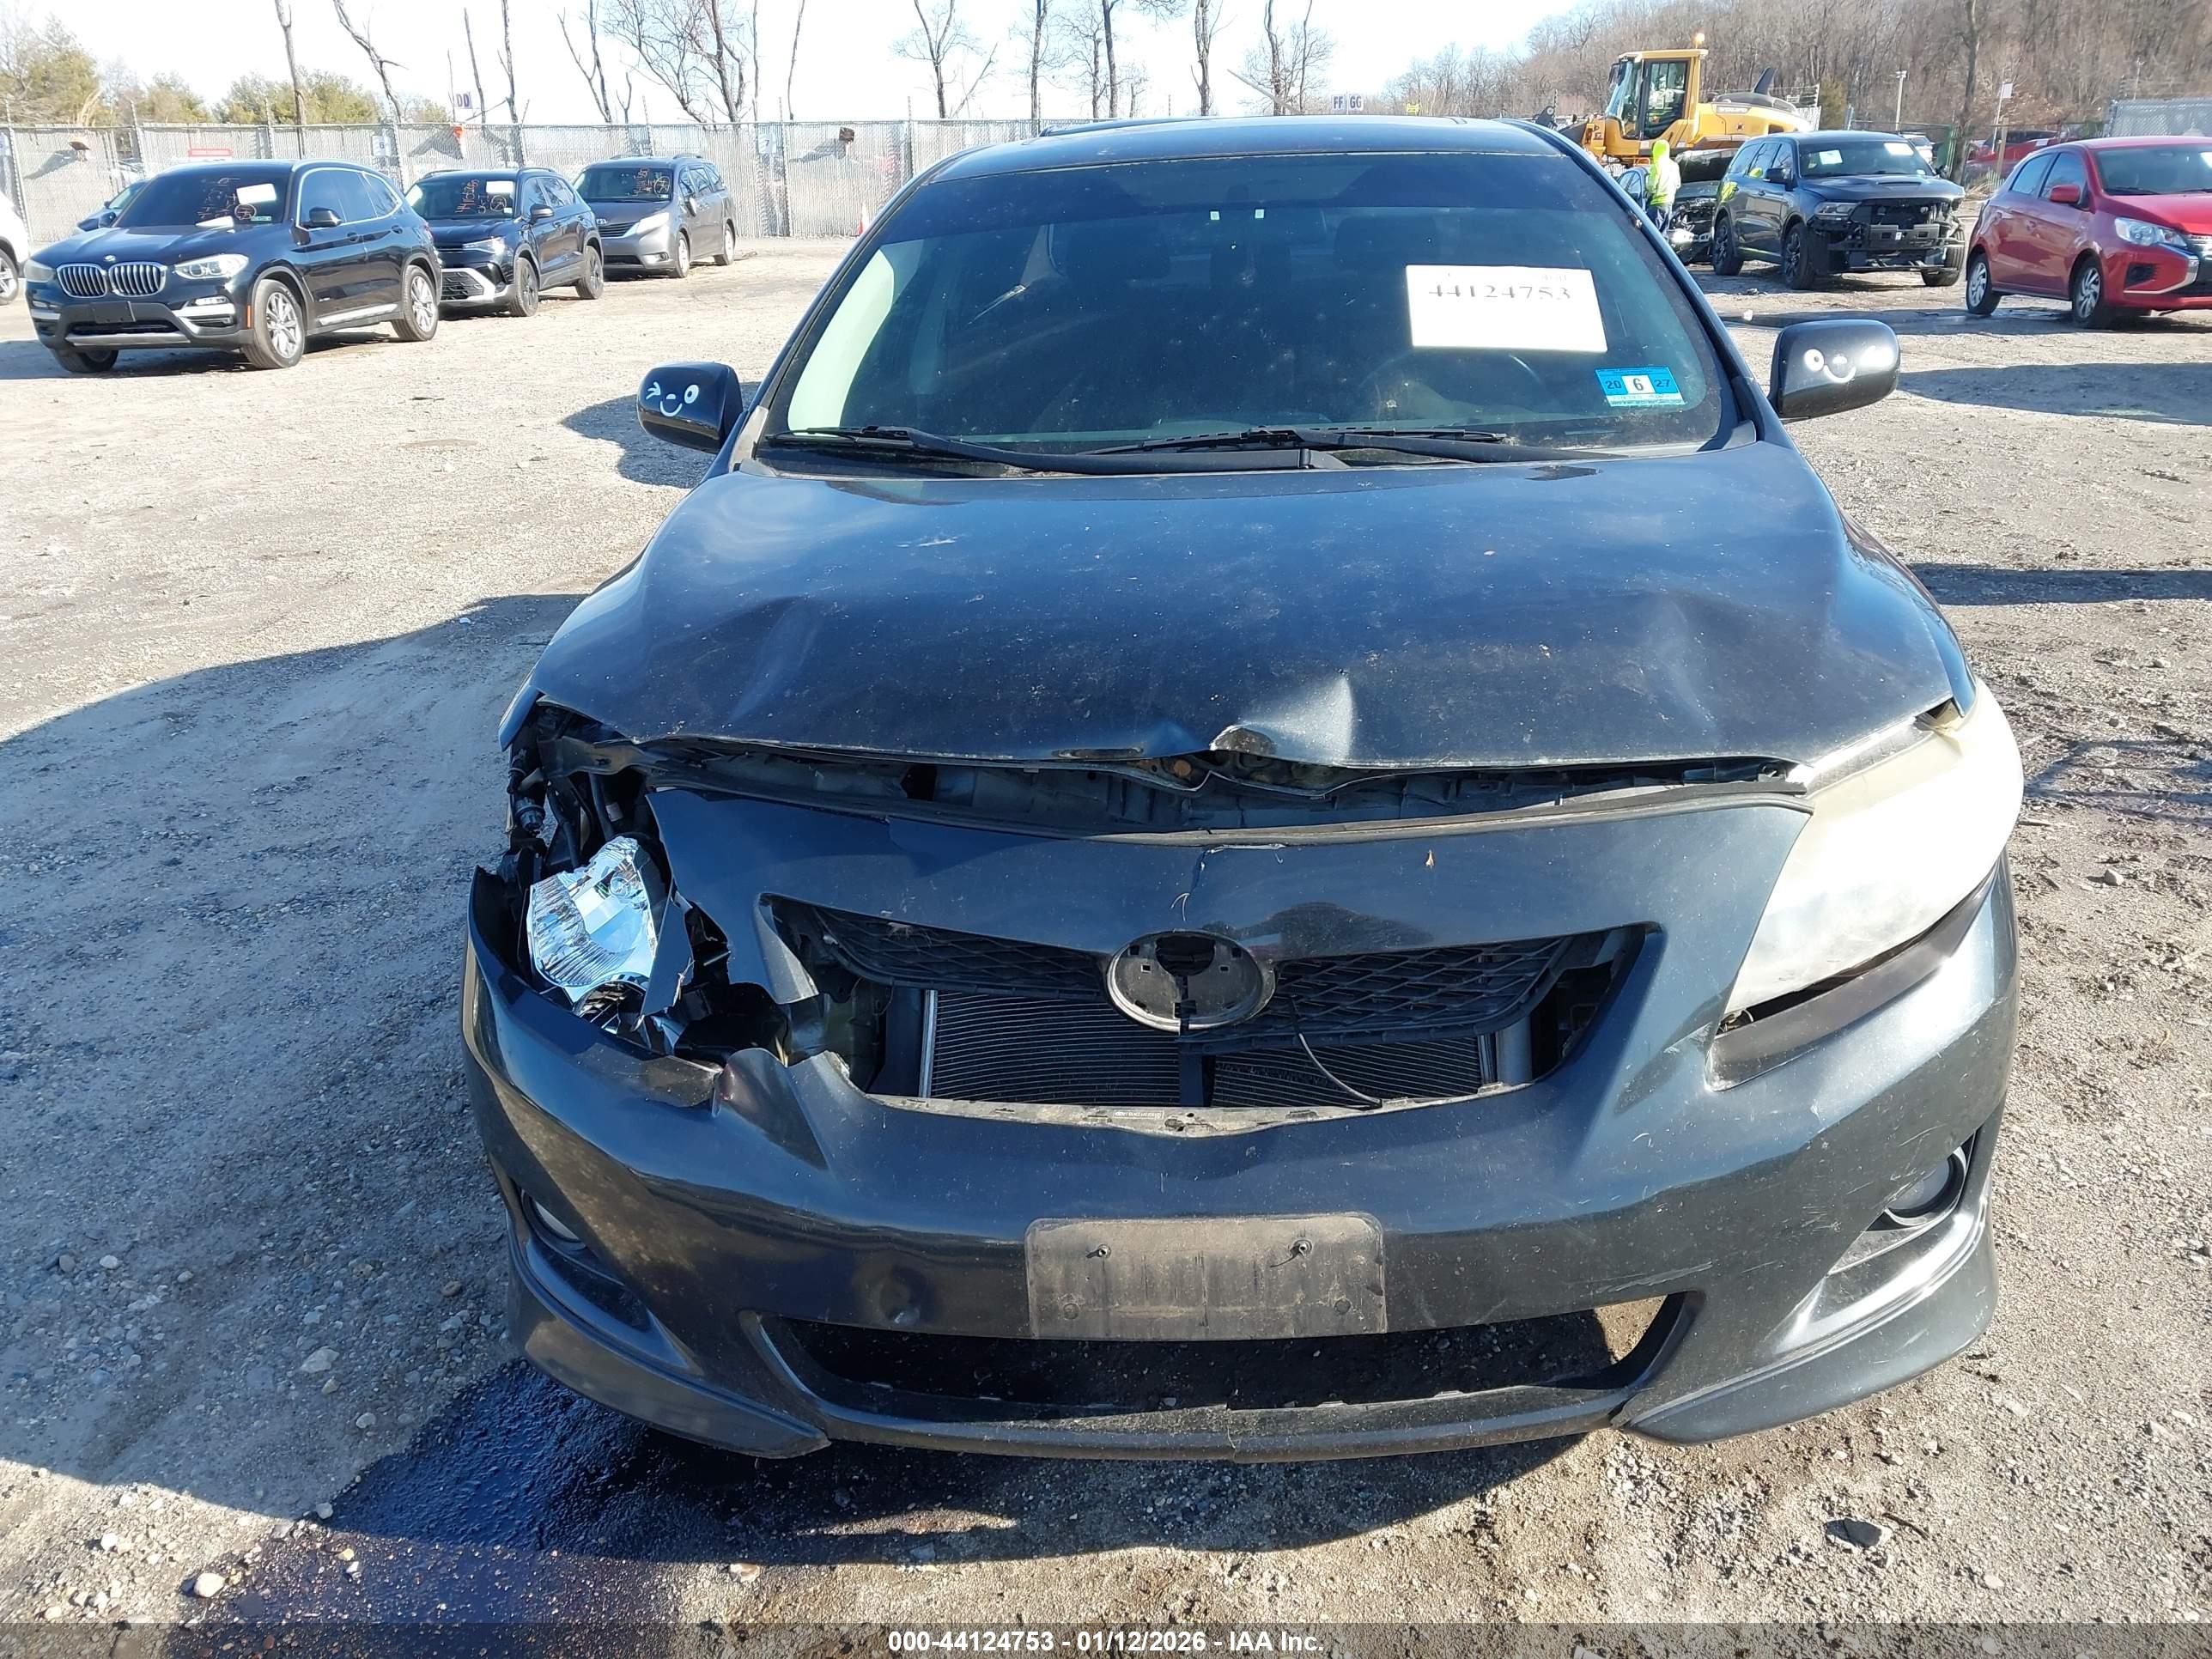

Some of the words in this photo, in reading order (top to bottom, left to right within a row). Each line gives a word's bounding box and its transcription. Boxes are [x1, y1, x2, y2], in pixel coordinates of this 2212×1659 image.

[456, 94, 470, 107] DD
[1334, 96, 1344, 109] FF
[1350, 95, 1362, 108] GG
[1605, 380, 1622, 390] 20
[1632, 378, 1644, 392] 6
[1655, 379, 1670, 388] 27
